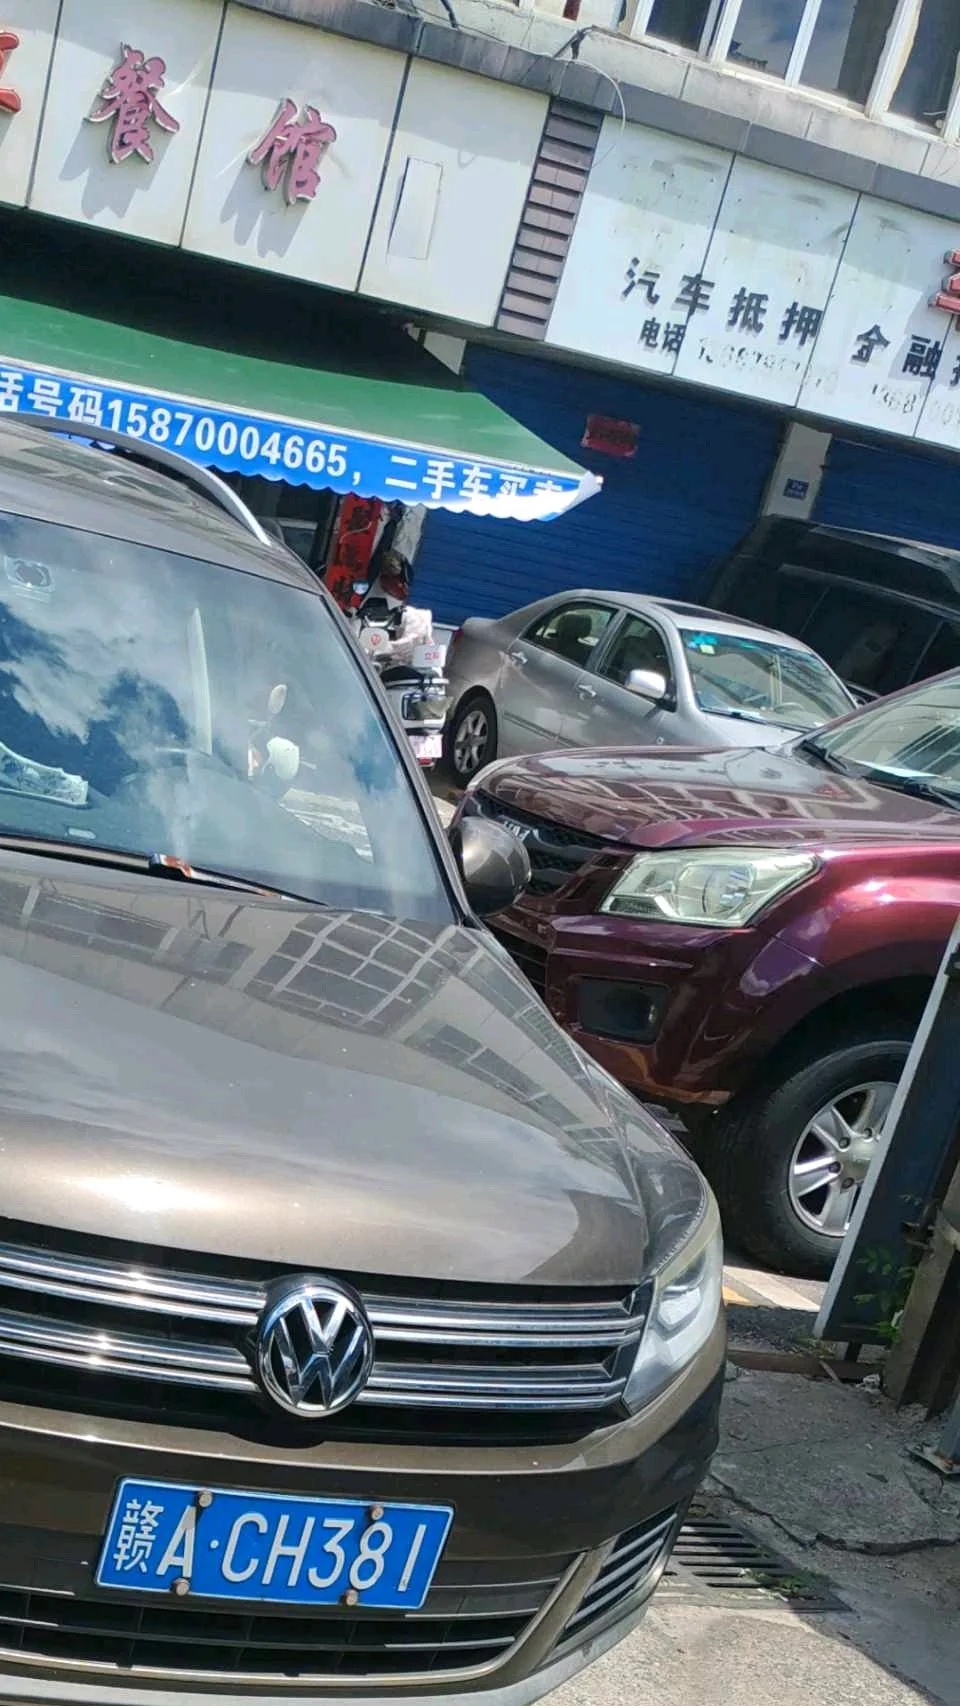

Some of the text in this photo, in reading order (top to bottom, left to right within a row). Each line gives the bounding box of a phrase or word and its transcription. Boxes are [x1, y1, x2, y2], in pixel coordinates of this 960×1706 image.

[622, 257, 823, 346] 汽车抵押
[851, 324, 960, 388] 金融
[640, 317, 687, 353] 电话
[113, 1499, 427, 1593] 赣A·CH381
